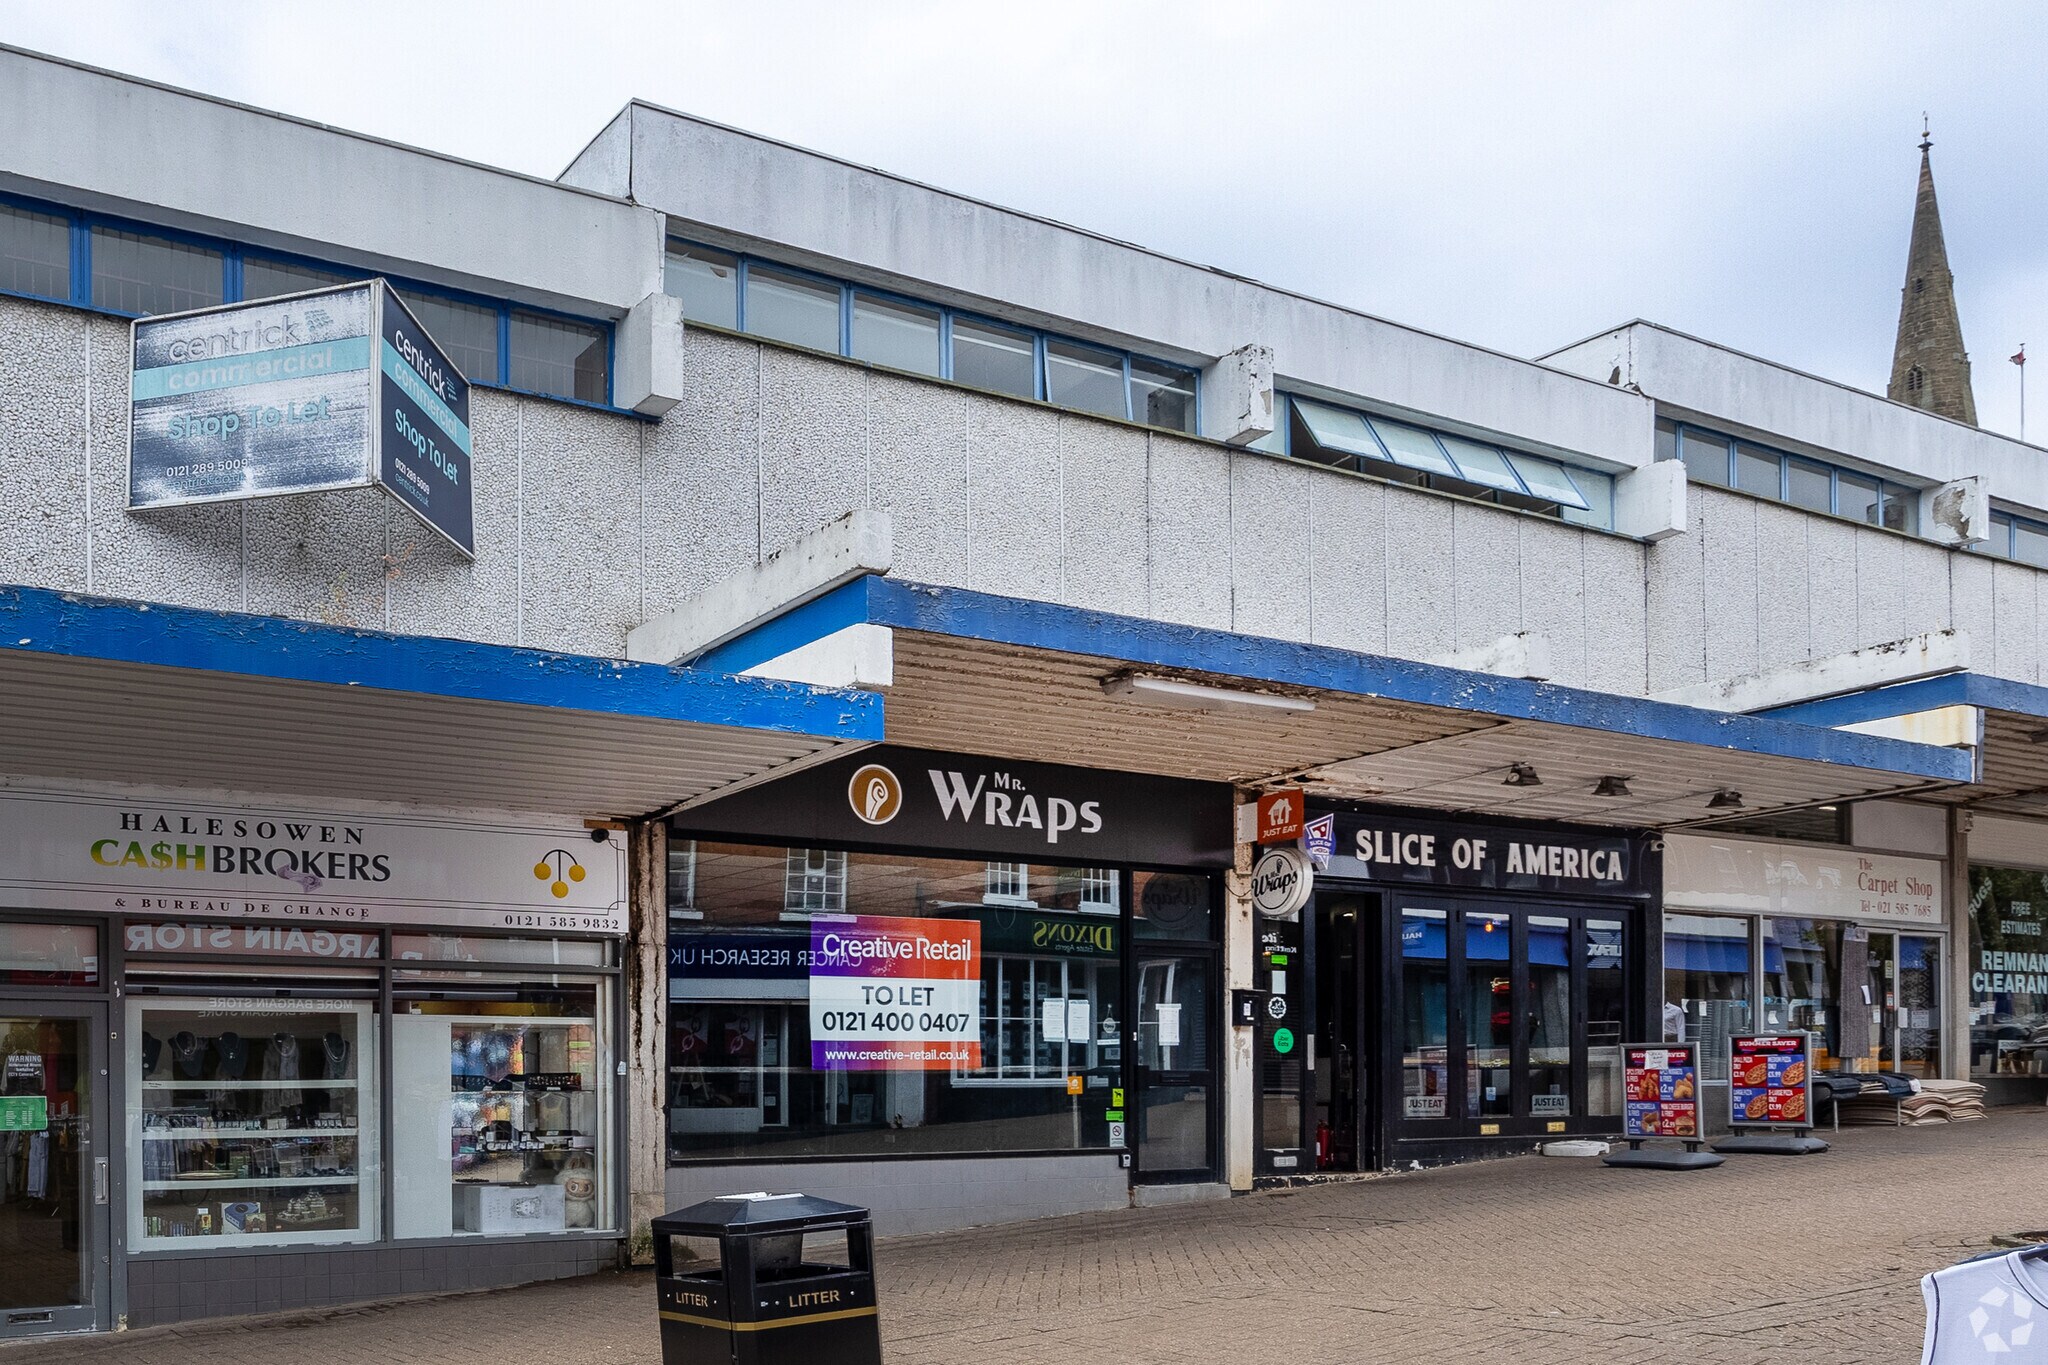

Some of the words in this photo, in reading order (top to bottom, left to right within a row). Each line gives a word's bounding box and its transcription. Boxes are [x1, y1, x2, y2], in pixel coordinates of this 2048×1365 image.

[168, 347, 332, 390] commercial
[394, 363, 457, 438] commercial
[168, 411, 240, 441] Shop
[247, 405, 282, 429] To
[287, 395, 331, 424] Let
[395, 408, 426, 459] Shop
[427, 438, 440, 468] To
[442, 453, 459, 485] Let
[166, 465, 190, 477] 0121
[192, 462, 215, 475] 289
[217, 458, 248, 471] 5009
[120, 812, 364, 845] HALESOWEN
[1263, 828, 1281, 839] JUST
[1282, 824, 1298, 834] EAT
[1356, 829, 1436, 867] SLICE
[1451, 838, 1487, 871] OF
[1506, 842, 1624, 881] AMERICA
[1858, 857, 1873, 870] The
[1251, 870, 1298, 898] Wraps
[1858, 871, 1898, 896] Carpet
[1905, 877, 1933, 900] Shop
[114, 897, 126, 908] &
[141, 898, 231, 912] BUREAU
[245, 902, 271, 913] DE
[283, 903, 370, 918] CHANGE
[1968, 877, 1993, 919] RUGS
[2011, 900, 2031, 915] FREE
[1895, 903, 1909, 915] 585
[1914, 904, 1932, 917] 7685
[504, 914, 541, 926] 0121
[549, 916, 576, 928] 585
[583, 918, 619, 930] 9832
[2000, 920, 2042, 936] ESTIMATES
[822, 933, 913, 960] Creative
[916, 937, 972, 961] Retail
[861, 985, 894, 1005] TO
[899, 986, 935, 1006] LET
[822, 1011, 866, 1031] 0121
[871, 1012, 914, 1032] 400
[919, 1013, 970, 1032] 0407
[825, 1048, 970, 1061] www.creative-retail.co.uk
[1408, 1099, 1427, 1109] JUST
[1428, 1099, 1443, 1108] EAT
[1533, 1097, 1551, 1107] JUST
[1551, 1096, 1565, 1107] EAT
[675, 1291, 709, 1308] LITTER
[789, 1289, 841, 1309] LITTER
